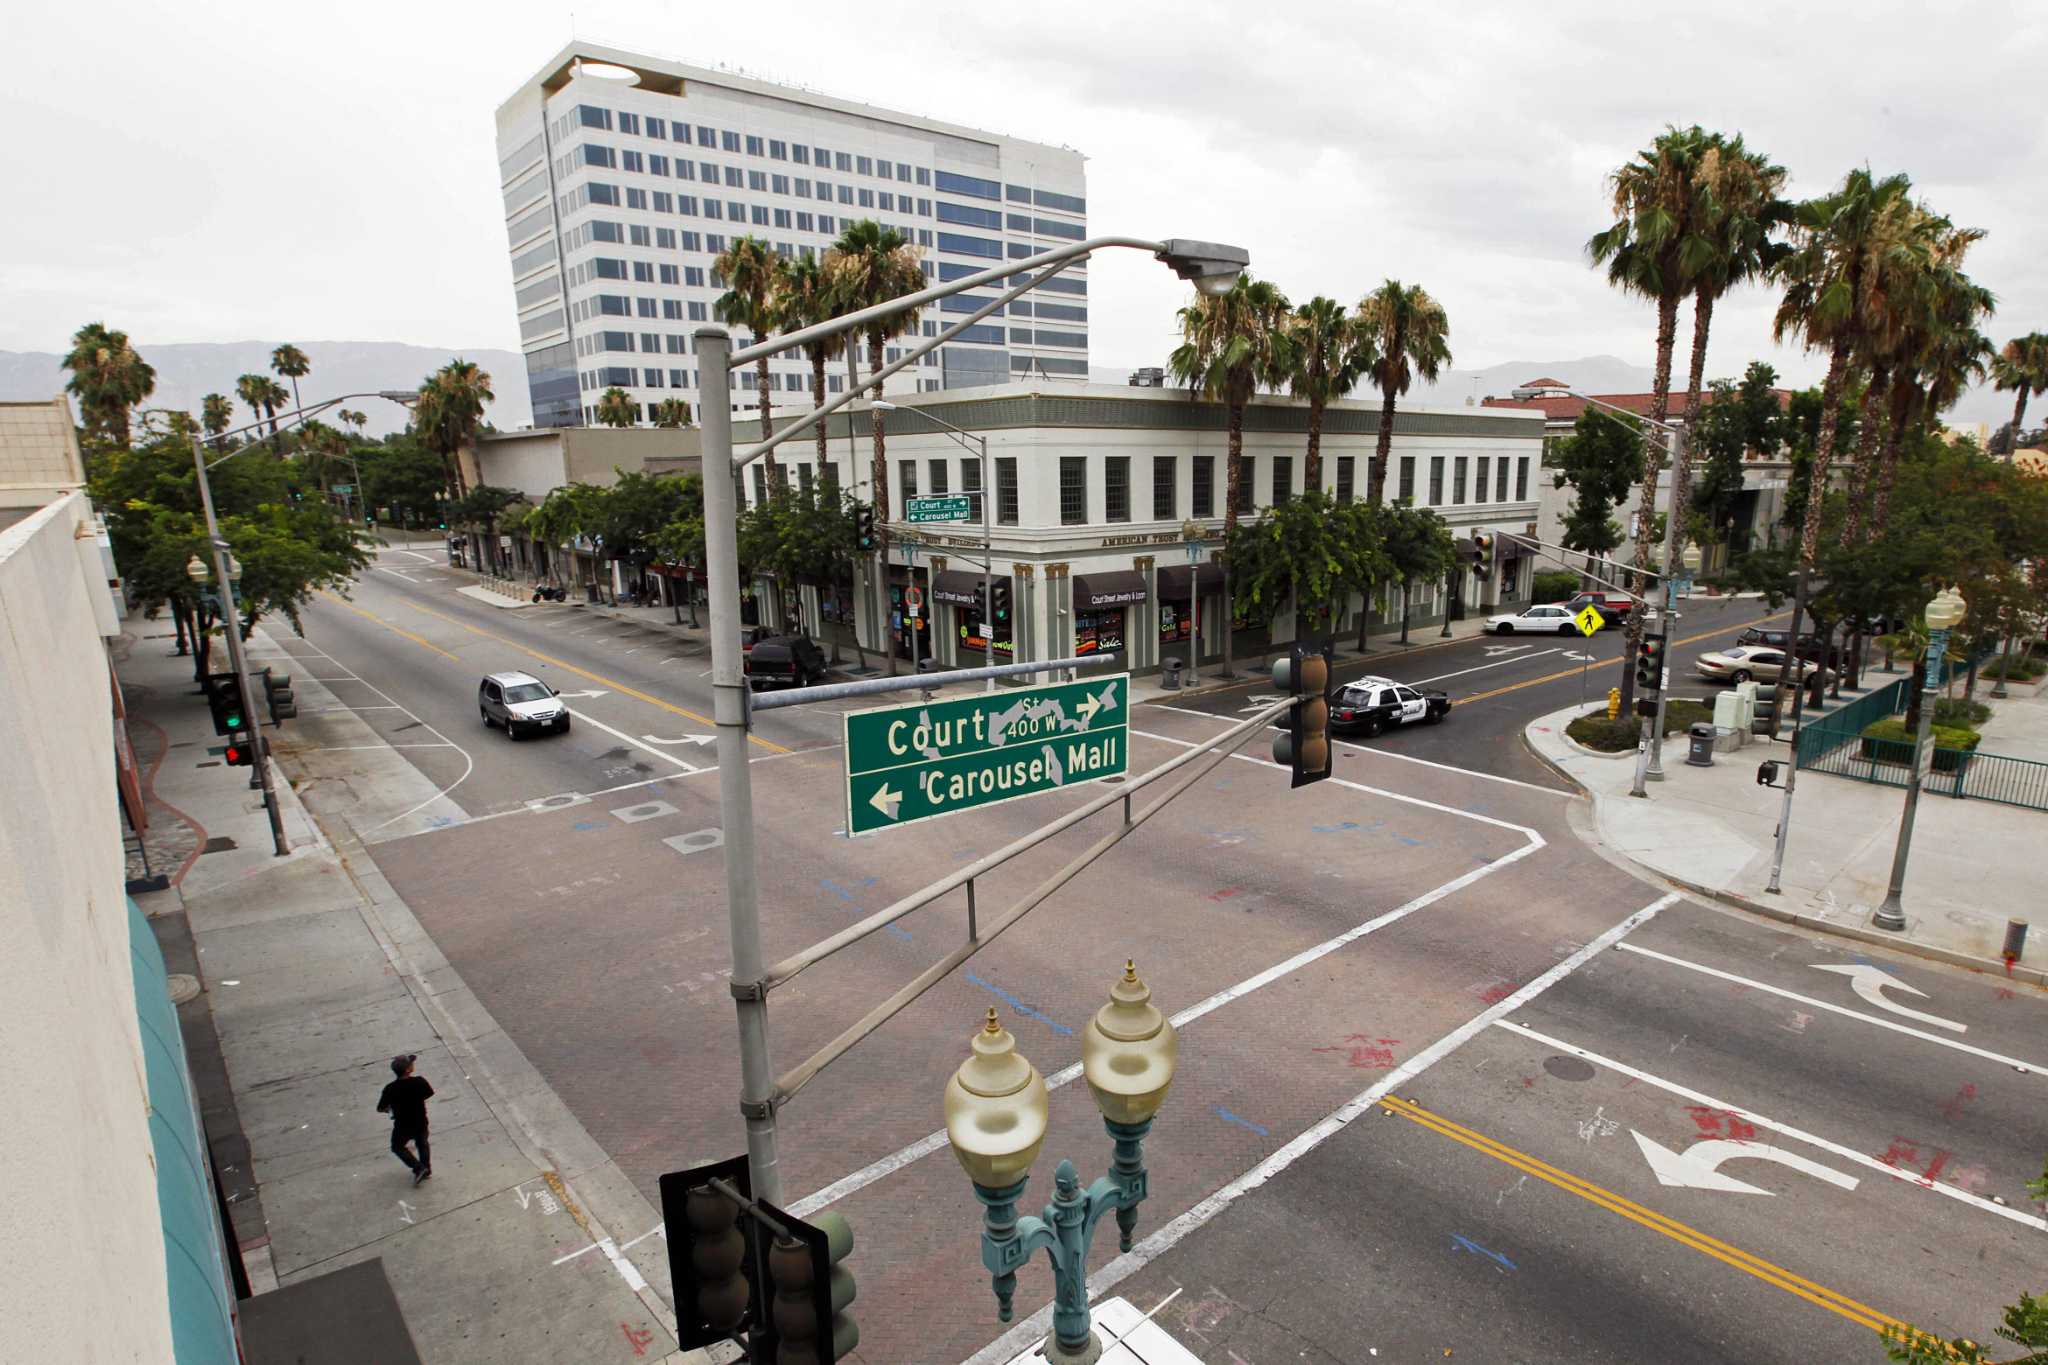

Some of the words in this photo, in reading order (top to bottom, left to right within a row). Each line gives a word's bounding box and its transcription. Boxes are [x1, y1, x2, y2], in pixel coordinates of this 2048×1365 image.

[920, 501, 941, 510] Court
[920, 511, 952, 521] Carousel
[953, 510, 968, 519] Mall
[888, 708, 984, 756] Court
[1023, 697, 1040, 713] St
[1007, 719, 1039, 738] 400
[1045, 714, 1057, 732] W
[926, 749, 1051, 805] Carousel
[1067, 736, 1116, 775] Mall
